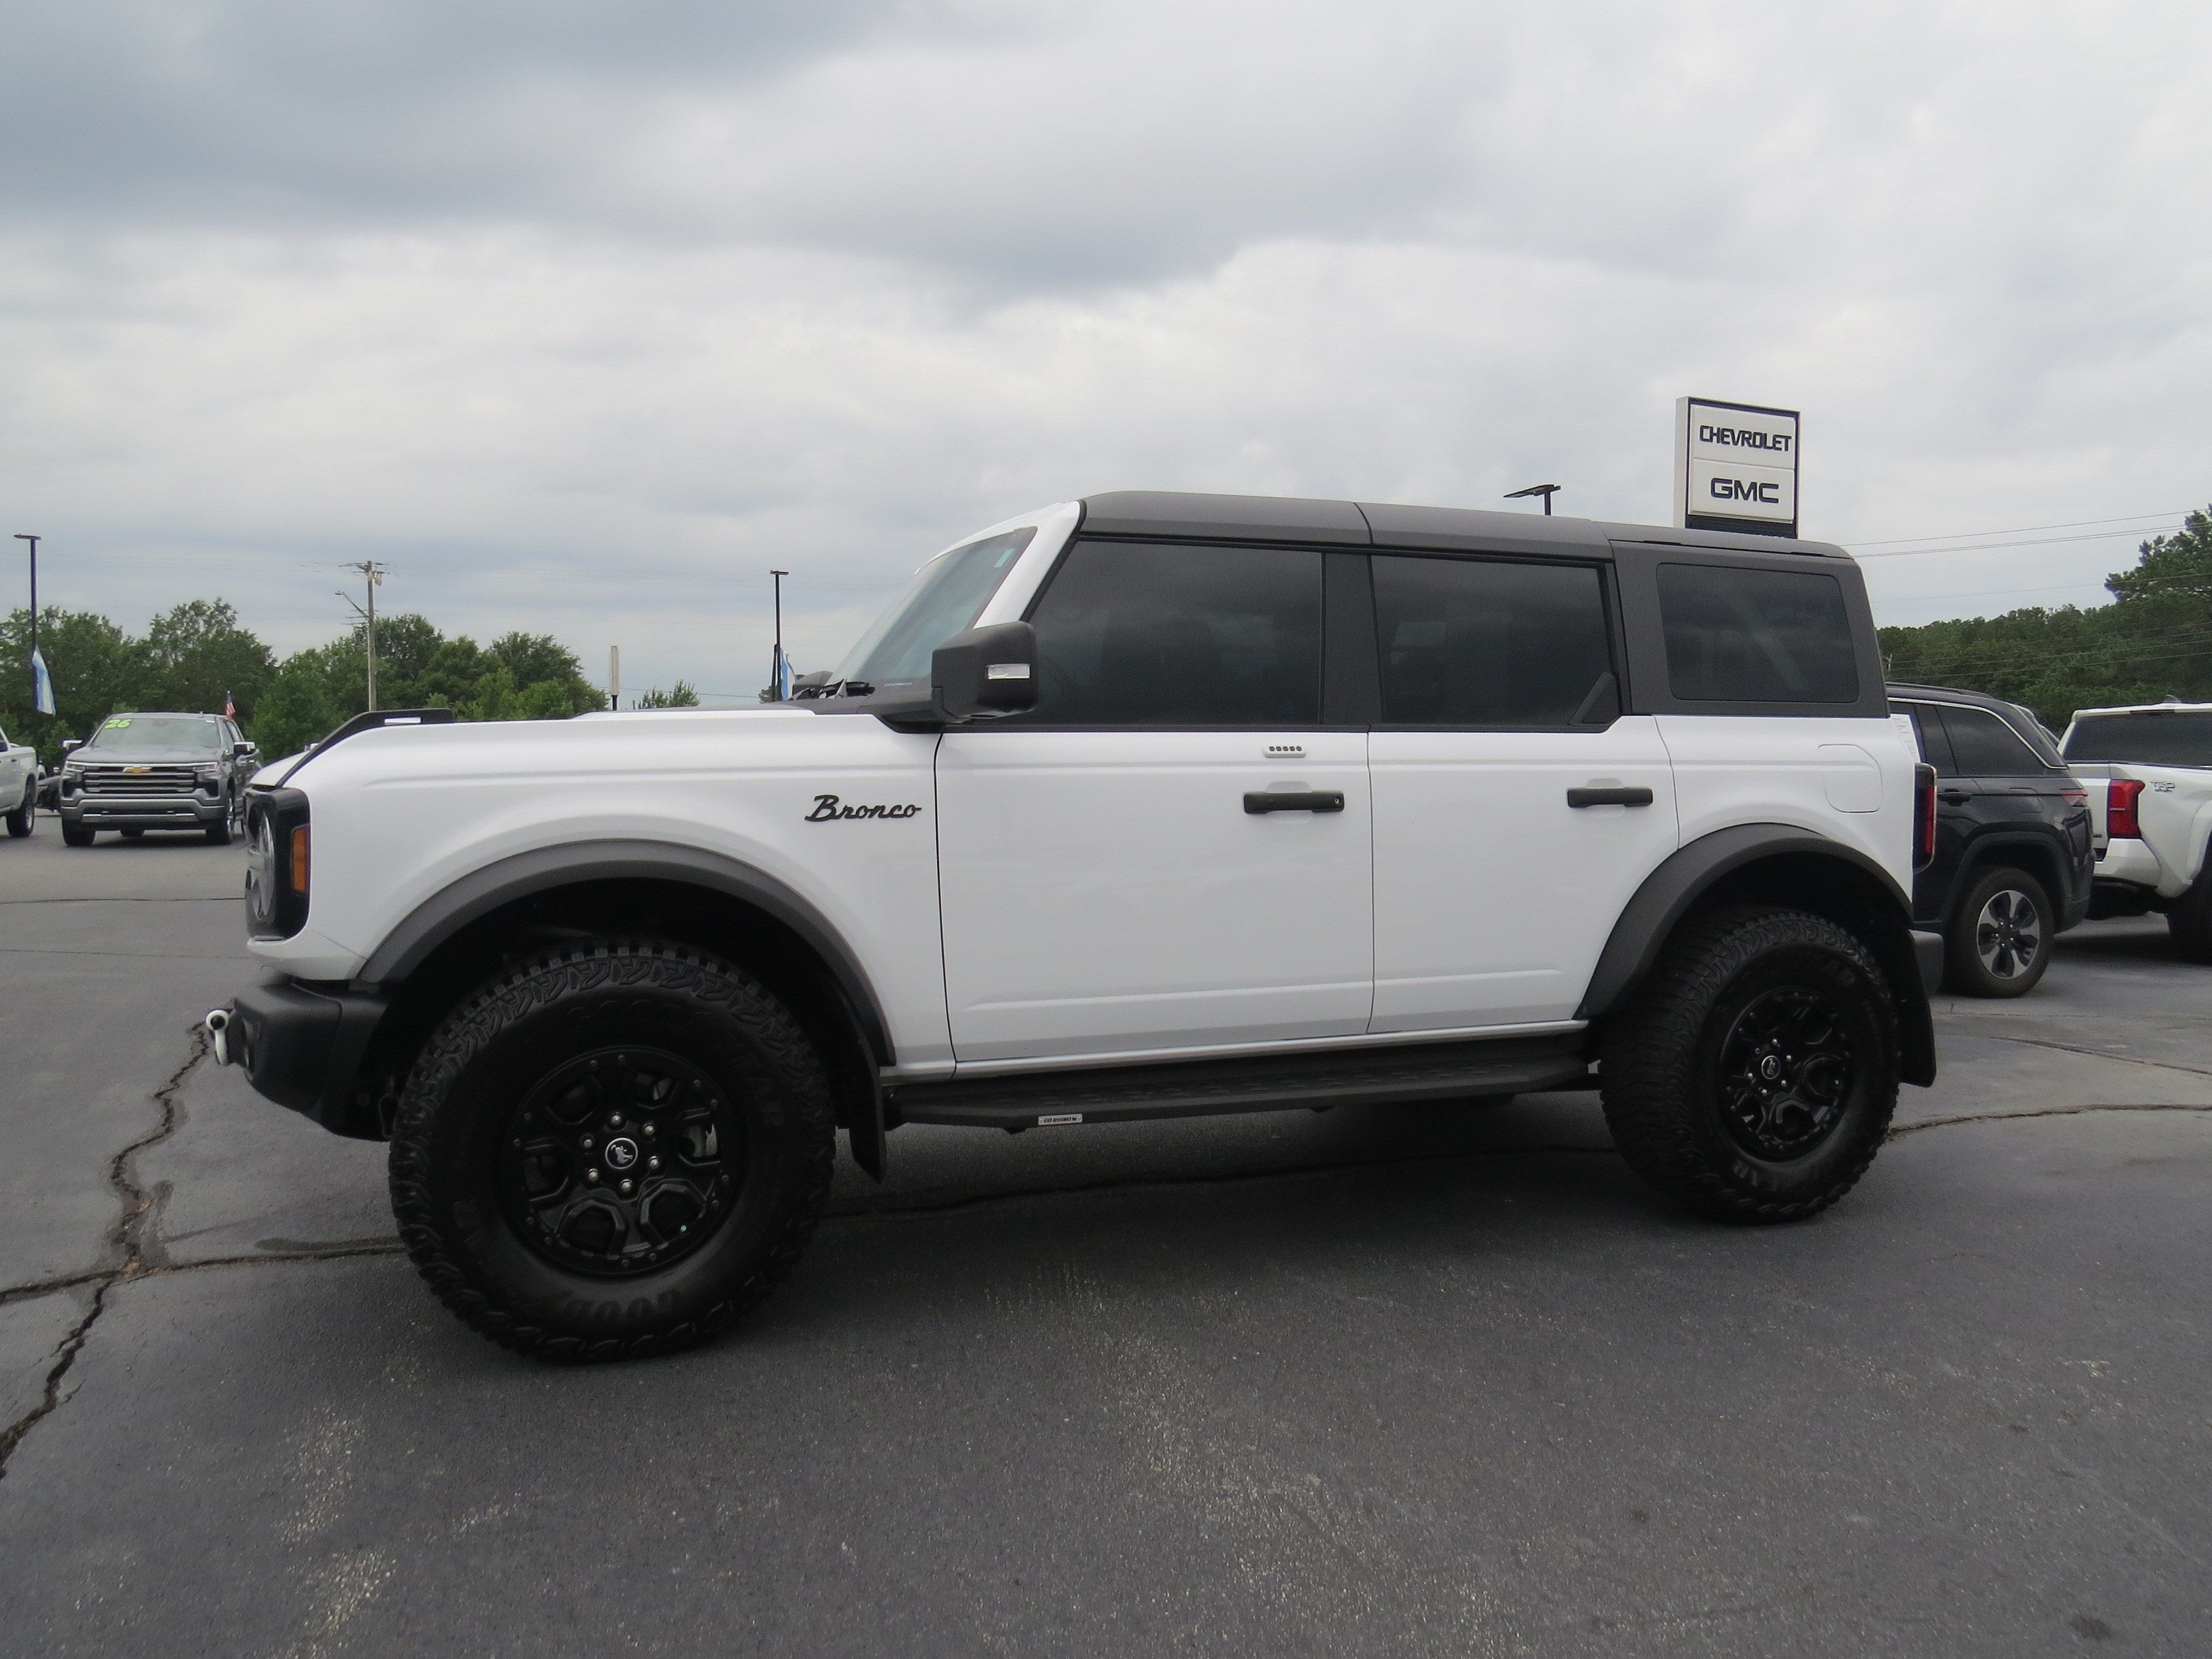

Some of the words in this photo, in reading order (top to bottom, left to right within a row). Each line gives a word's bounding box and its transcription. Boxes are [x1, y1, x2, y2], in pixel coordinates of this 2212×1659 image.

[1699, 425, 1792, 451] CHEVROLET
[1710, 478, 1779, 503] GMC
[105, 719, 131, 728] 26
[804, 795, 922, 822] Bronco
